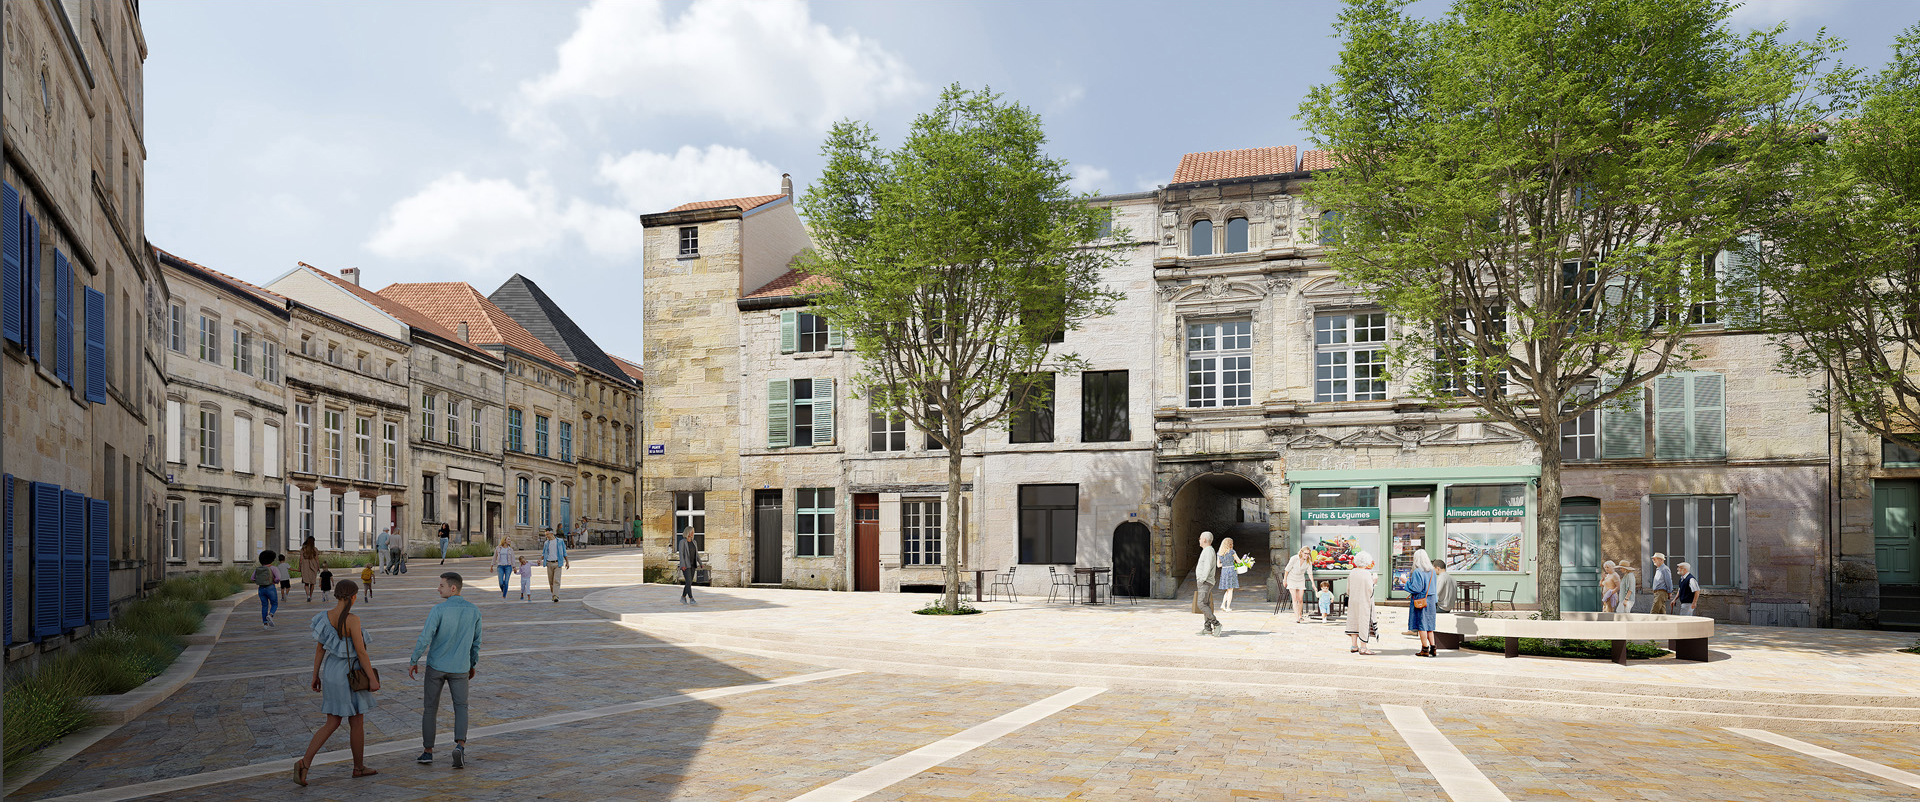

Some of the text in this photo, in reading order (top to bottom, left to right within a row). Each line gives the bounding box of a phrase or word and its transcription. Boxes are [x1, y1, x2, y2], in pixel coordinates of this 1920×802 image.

[1337, 511, 1370, 520] Légumes
[1446, 508, 1523, 517] Alimentation Générale
